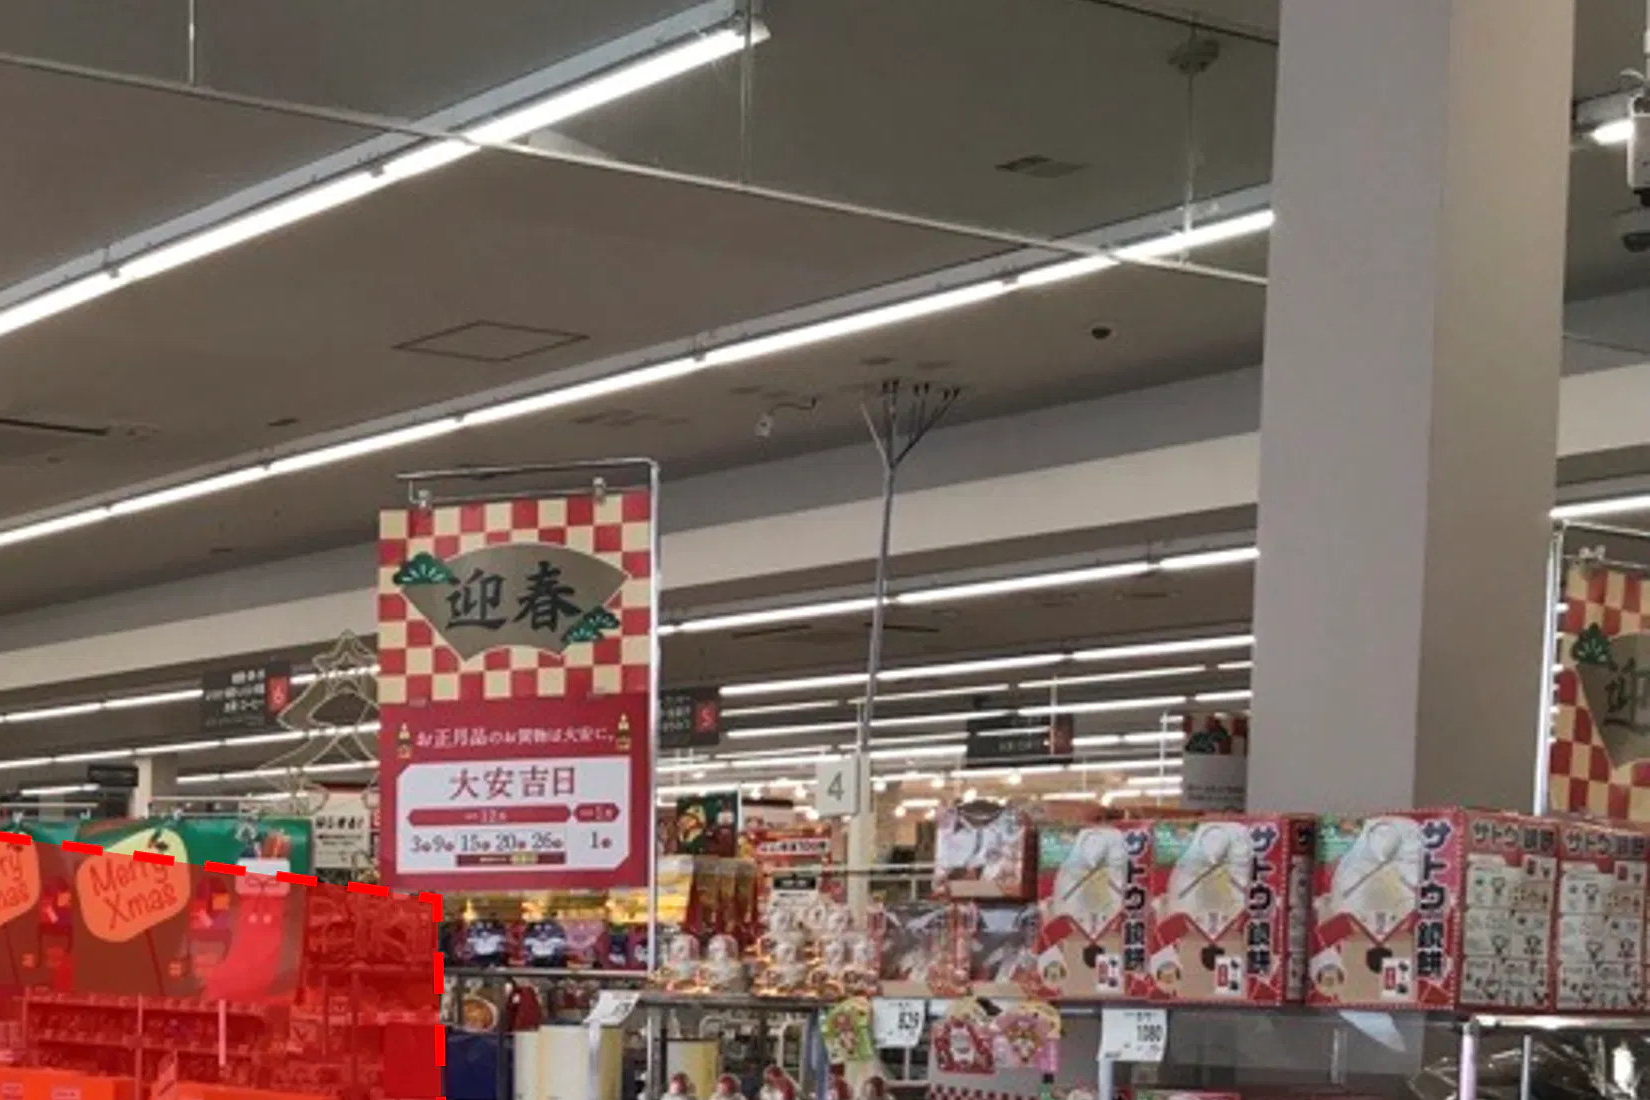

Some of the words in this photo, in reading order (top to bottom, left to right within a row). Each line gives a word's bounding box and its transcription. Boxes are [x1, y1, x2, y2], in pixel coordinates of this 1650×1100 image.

[445, 560, 582, 631] 迎春
[450, 766, 576, 800] 大安吉日
[828, 771, 844, 801] 4
[460, 833, 479, 851] 15
[496, 832, 516, 850] 20
[90, 852, 171, 893] Merry
[107, 883, 177, 930] Xmas
